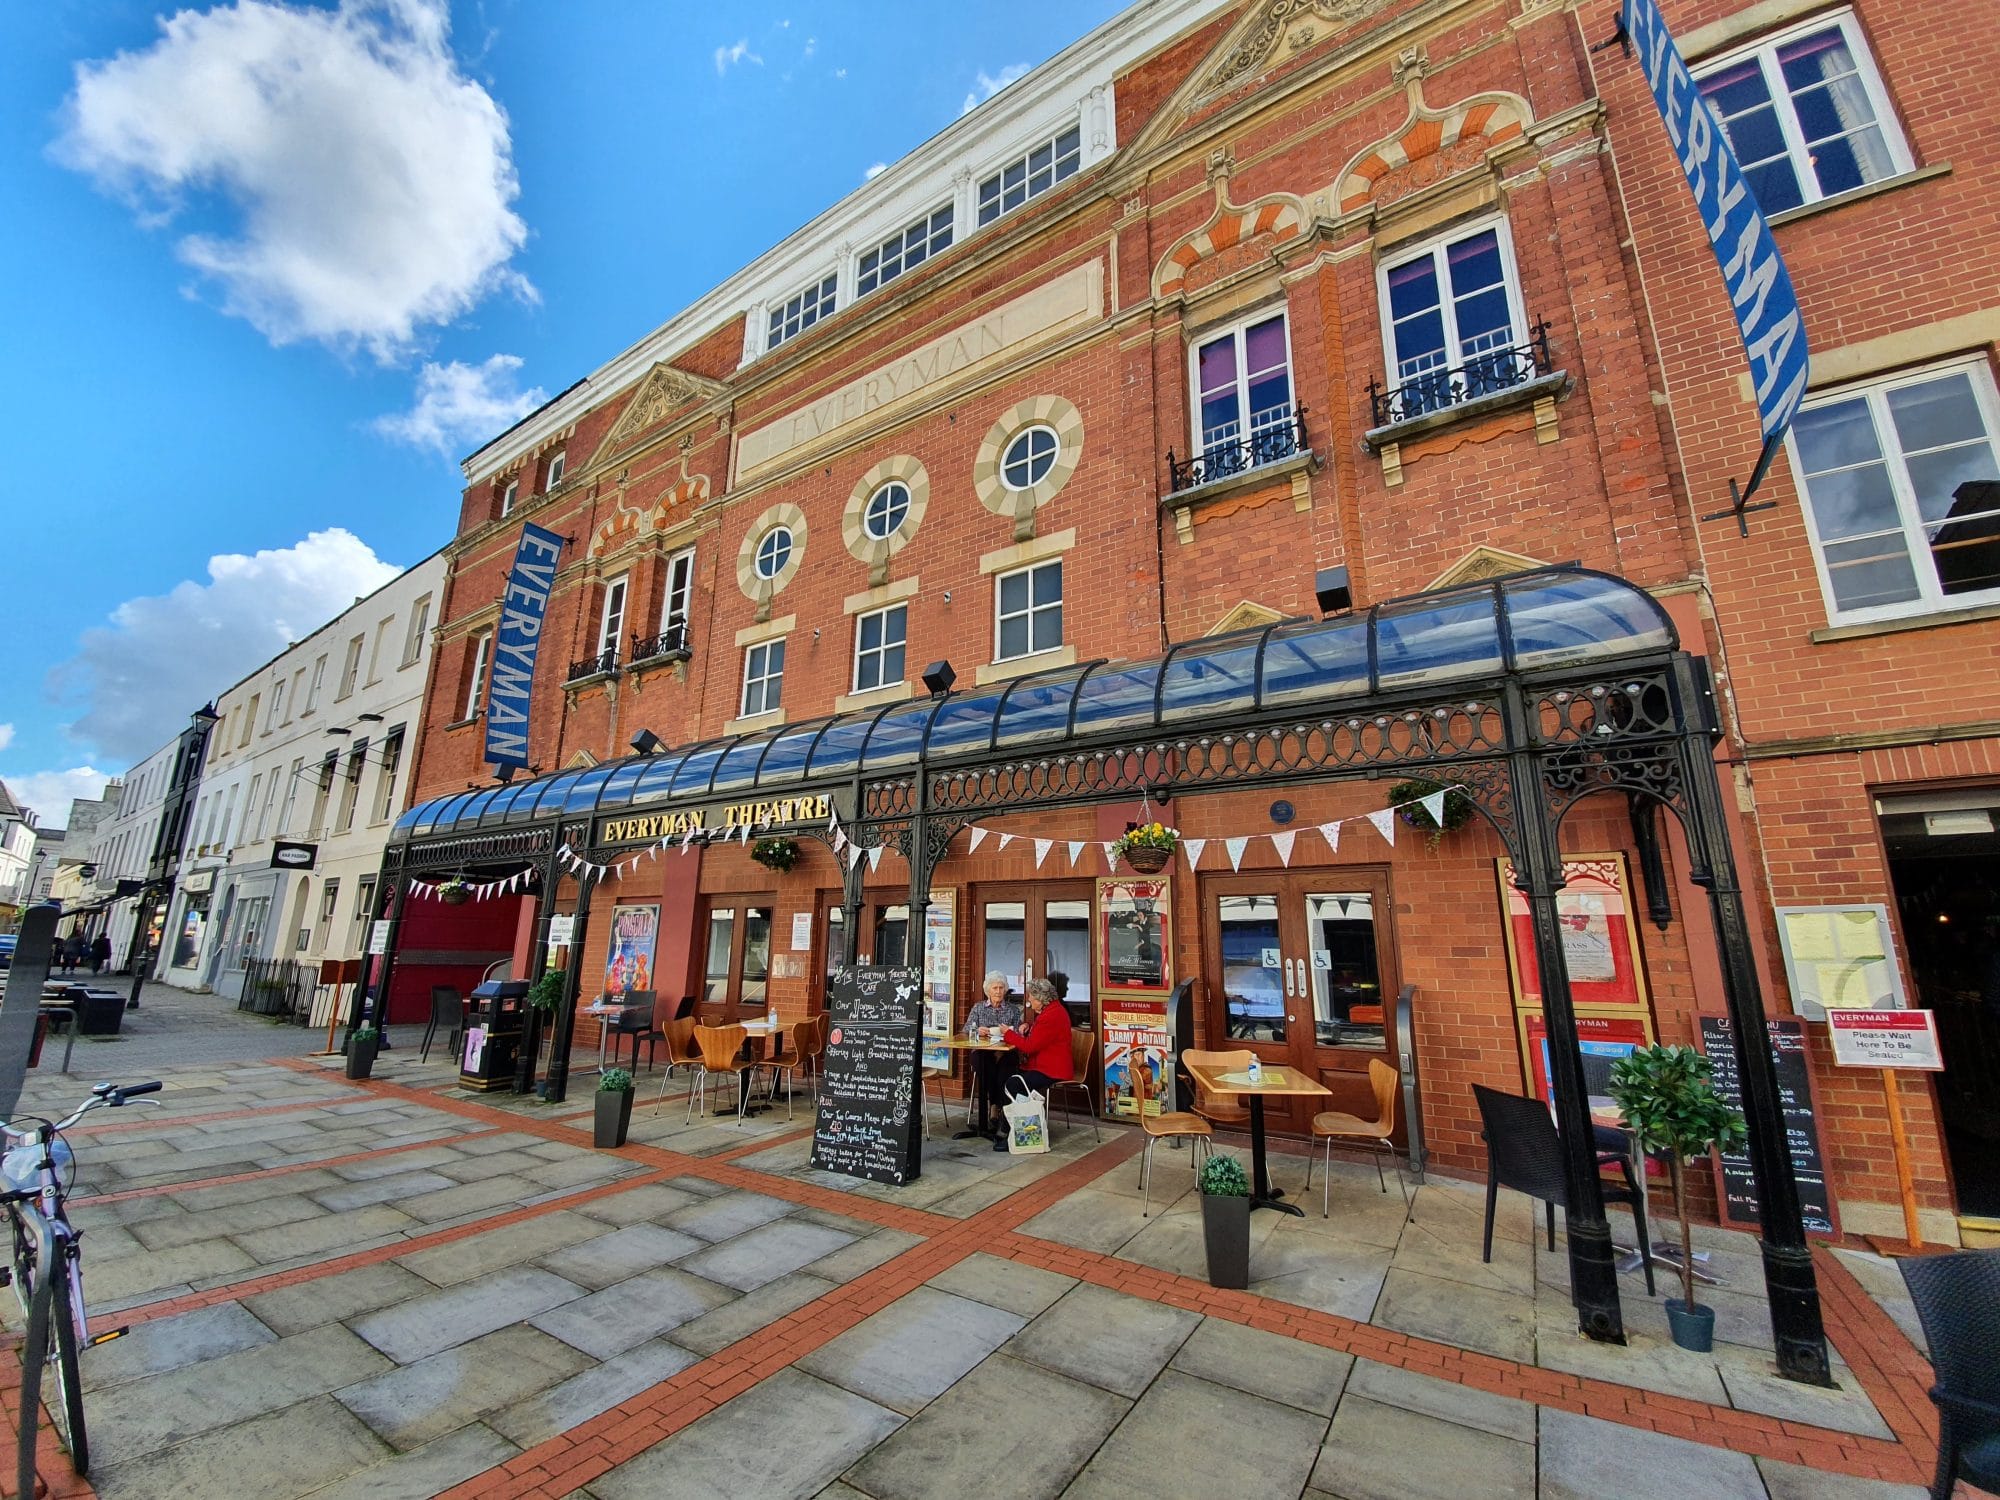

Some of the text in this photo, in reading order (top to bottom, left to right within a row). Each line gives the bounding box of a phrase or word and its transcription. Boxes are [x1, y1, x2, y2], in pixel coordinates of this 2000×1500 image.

[791, 316, 1004, 446] EVERYMAN
[488, 532, 562, 758] EVERYMAN
[604, 795, 830, 842] EVERYMAN THEATRE
[618, 914, 654, 936] PRISCILLA
[1120, 1001, 1151, 1009] EVERYMAN
[1833, 1014, 1890, 1022] EVERYMAN
[1575, 1019, 1608, 1027] RYMAN
[1108, 1030, 1166, 1046] BARMY BRITAIN
[1703, 1031, 1725, 1039] Filter
[1852, 1031, 1912, 1040] Please Wait
[1856, 1041, 1912, 1050] Here To Be
[1867, 1050, 1904, 1059] Seated
[822, 1109, 834, 1119] Our
[845, 1111, 862, 1121] Course
[864, 1112, 880, 1124] Menu
